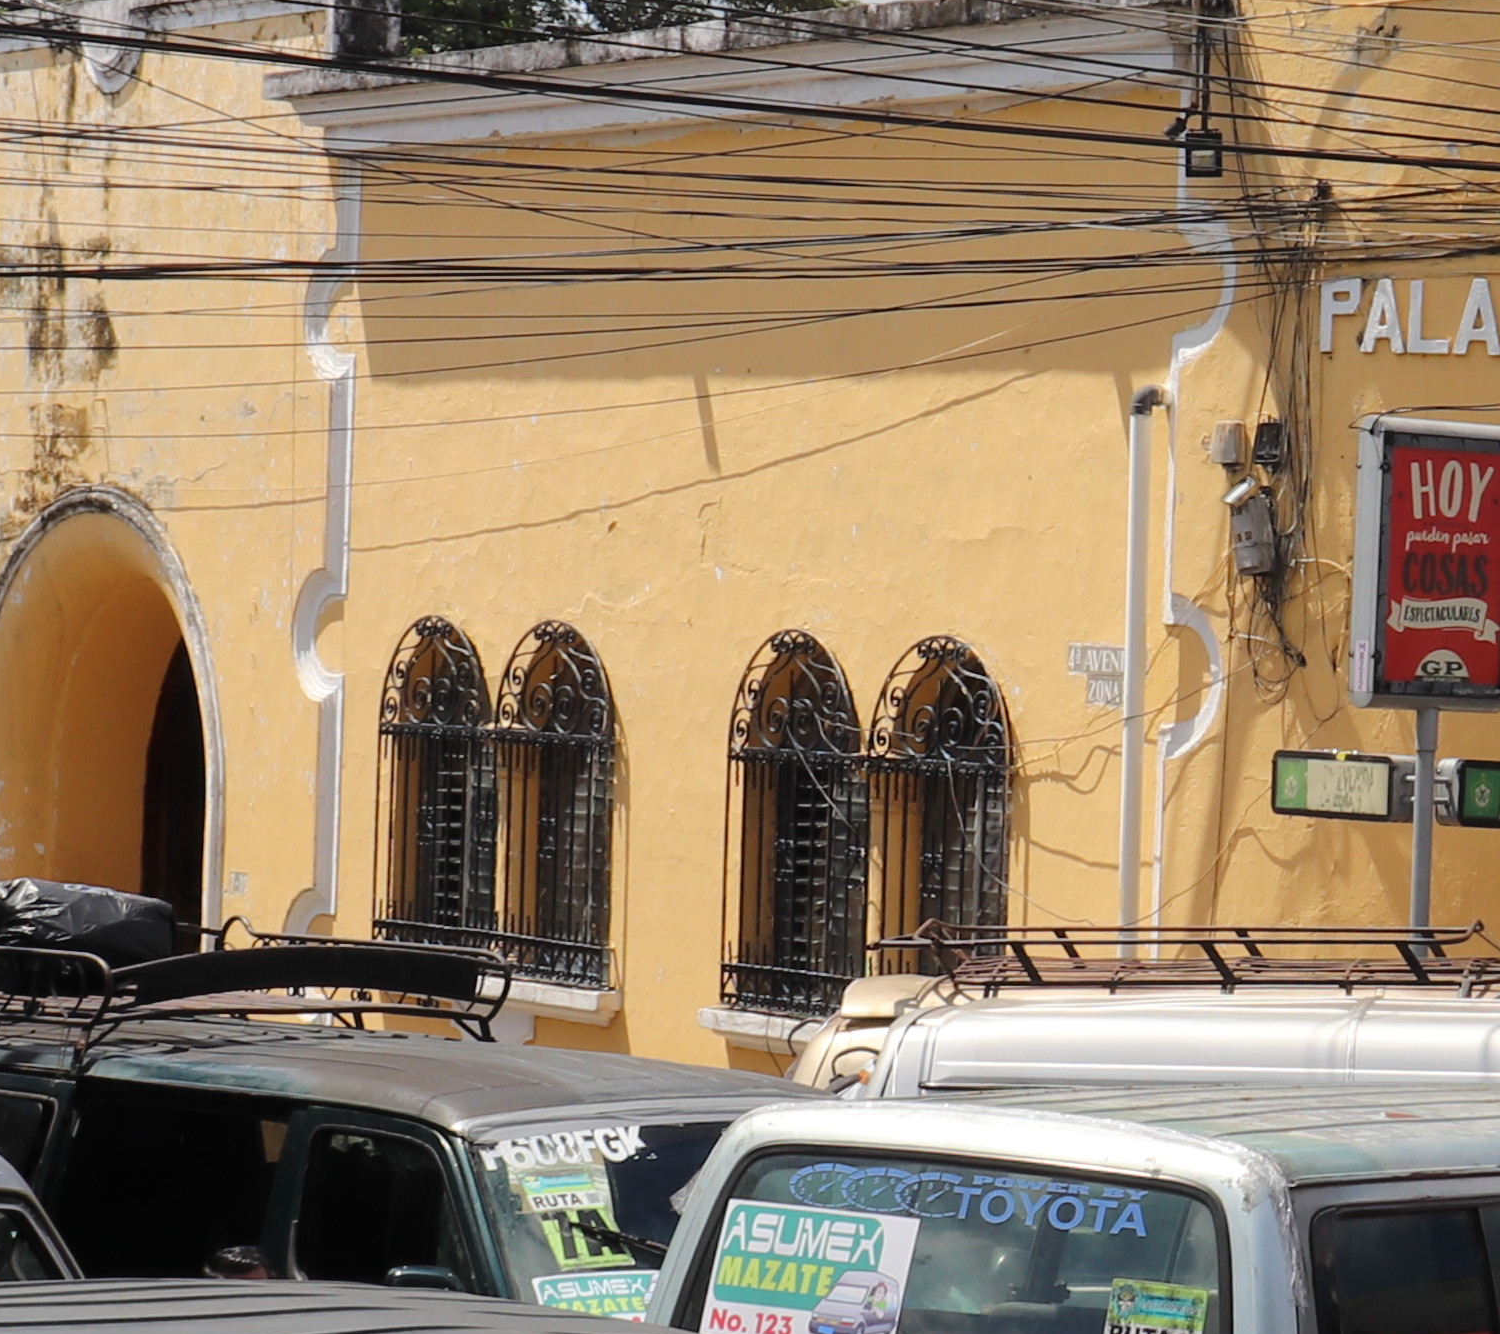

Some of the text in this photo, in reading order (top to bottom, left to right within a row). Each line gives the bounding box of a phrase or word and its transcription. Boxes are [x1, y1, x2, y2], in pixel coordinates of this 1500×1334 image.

[1410, 460, 1494, 523] HOY
[1405, 526, 1490, 553] pueden pasar
[1402, 551, 1488, 597] COSAS
[1404, 604, 1480, 624] ESPECTACULARES
[1084, 649, 1124, 672] AVENI
[1421, 660, 1463, 675] GP
[1088, 679, 1119, 702] ZONA
[971, 1174, 1148, 1201] POWER BY
[532, 1193, 583, 1209] RUTA
[954, 1186, 1148, 1238] TOYOTA
[724, 1212, 883, 1265] ASUMEX
[542, 1277, 647, 1300] ASUMEX
[717, 1255, 835, 1297] MAZATE
[709, 1308, 747, 1333] No.
